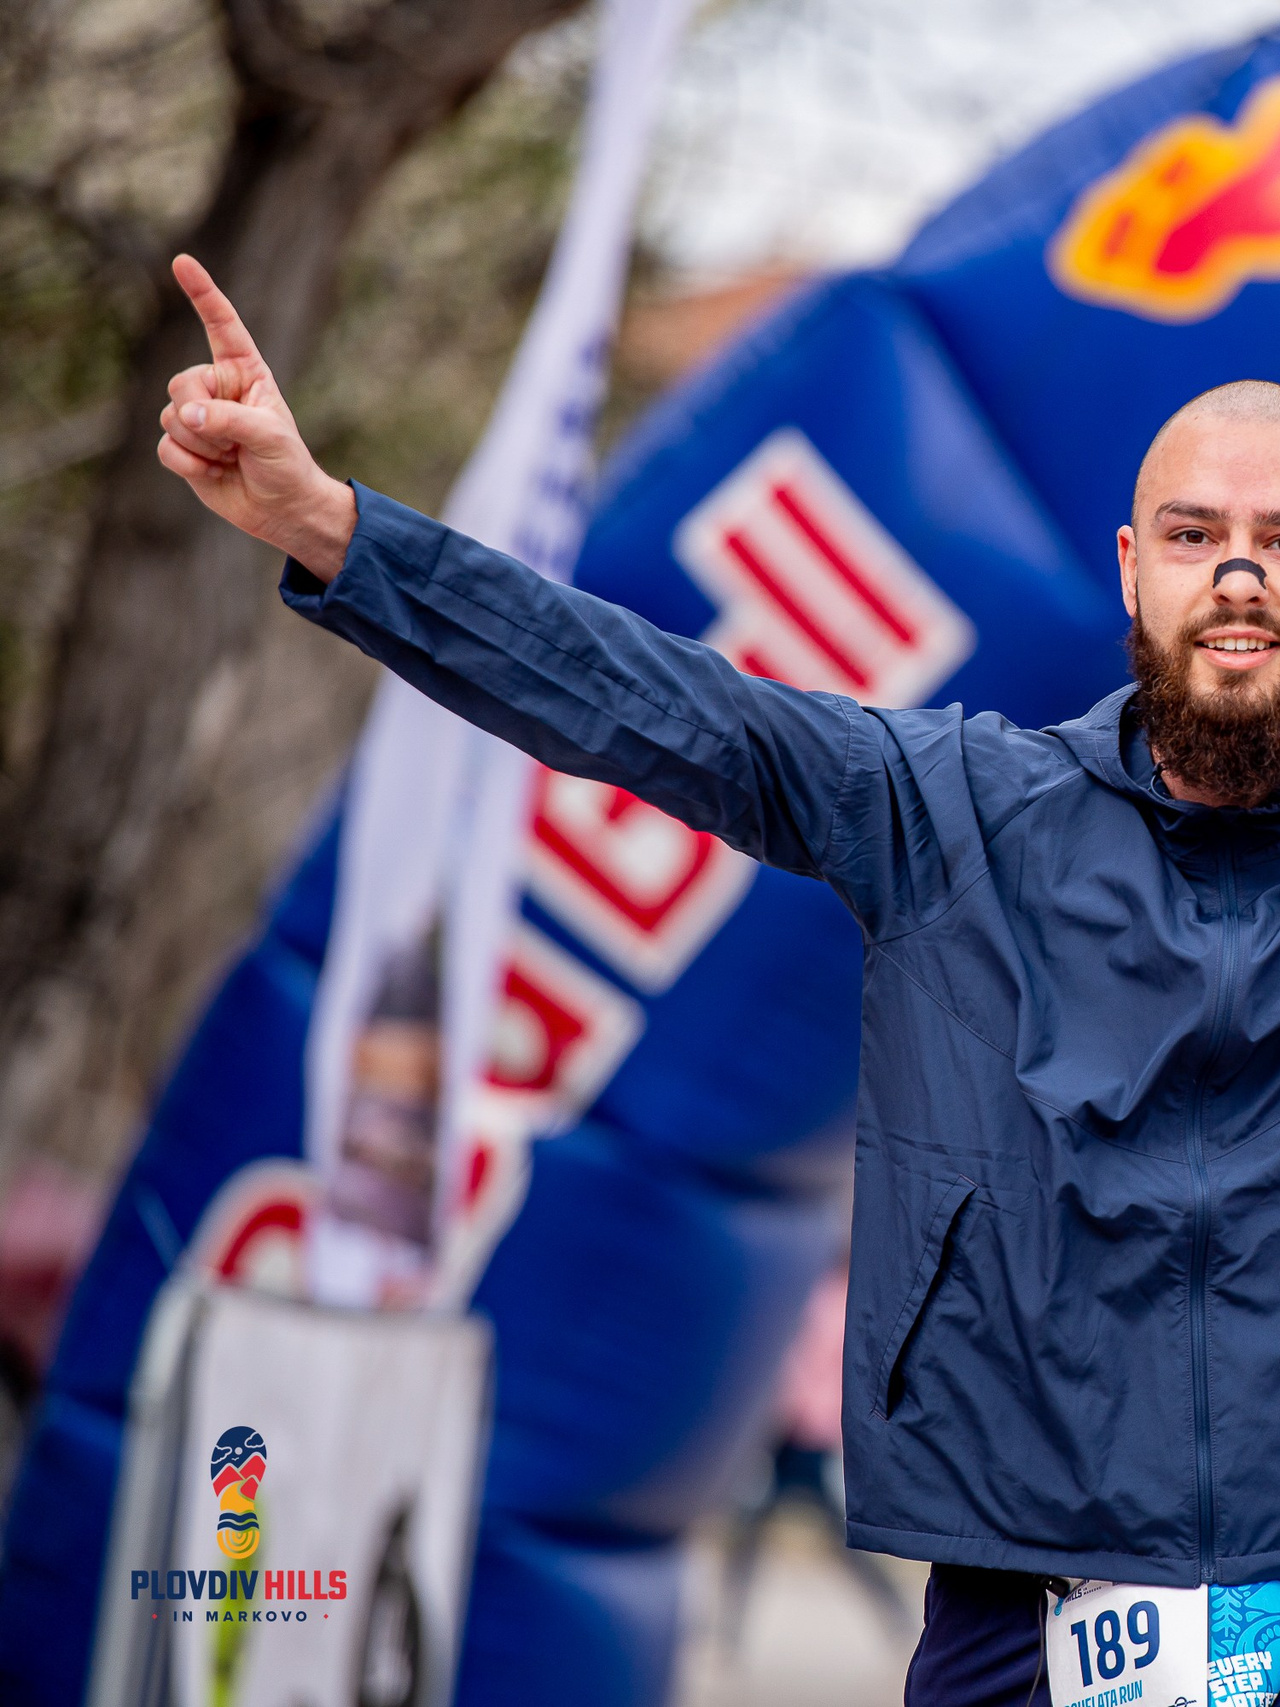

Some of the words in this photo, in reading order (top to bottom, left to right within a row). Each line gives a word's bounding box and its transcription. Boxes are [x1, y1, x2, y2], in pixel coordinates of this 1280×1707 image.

[525, 470, 925, 948] Bll
[1070, 1600, 1160, 1688] 189
[1206, 1651, 1273, 1681] EVERY
[1119, 1680, 1143, 1704] RUN
[1208, 1671, 1264, 1699] STEP
